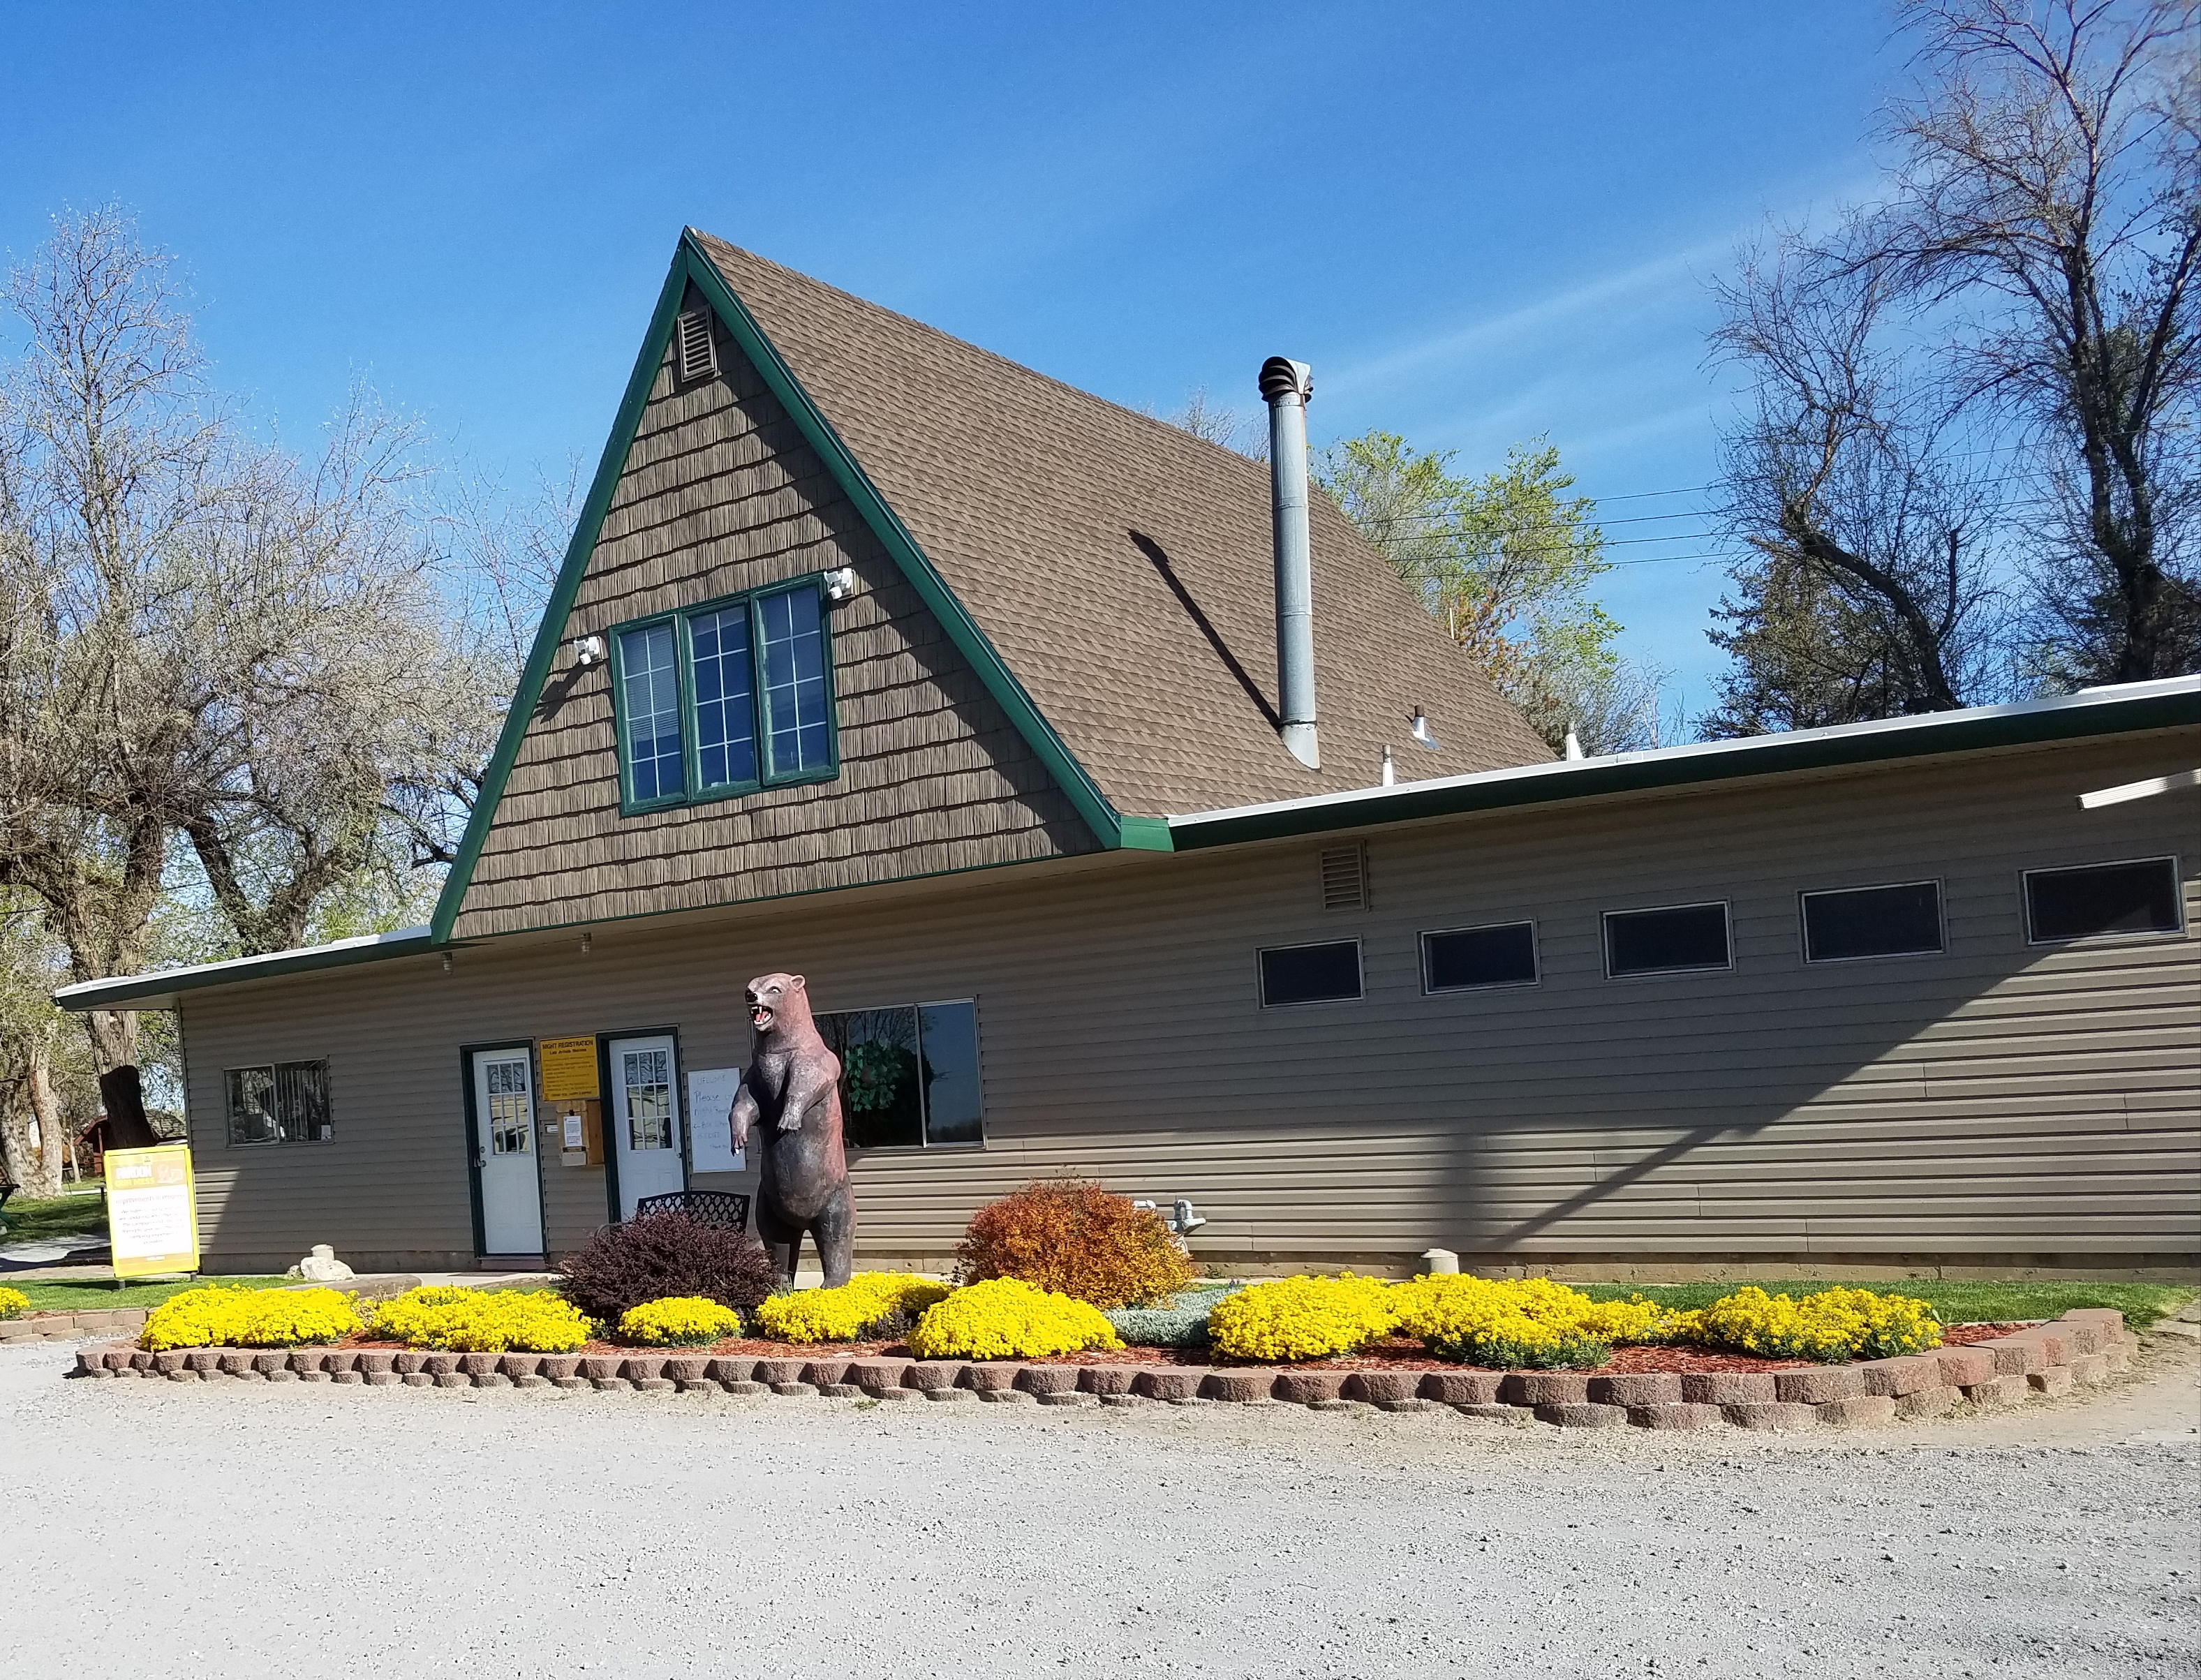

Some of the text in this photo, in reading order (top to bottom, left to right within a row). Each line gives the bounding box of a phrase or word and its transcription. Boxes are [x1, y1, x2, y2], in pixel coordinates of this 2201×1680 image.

[558, 1039, 593, 1048] REGISTRATION
[694, 1090, 720, 1103] Please
[116, 1165, 153, 1180] PARDON
[115, 1177, 155, 1187] OUR MESS
